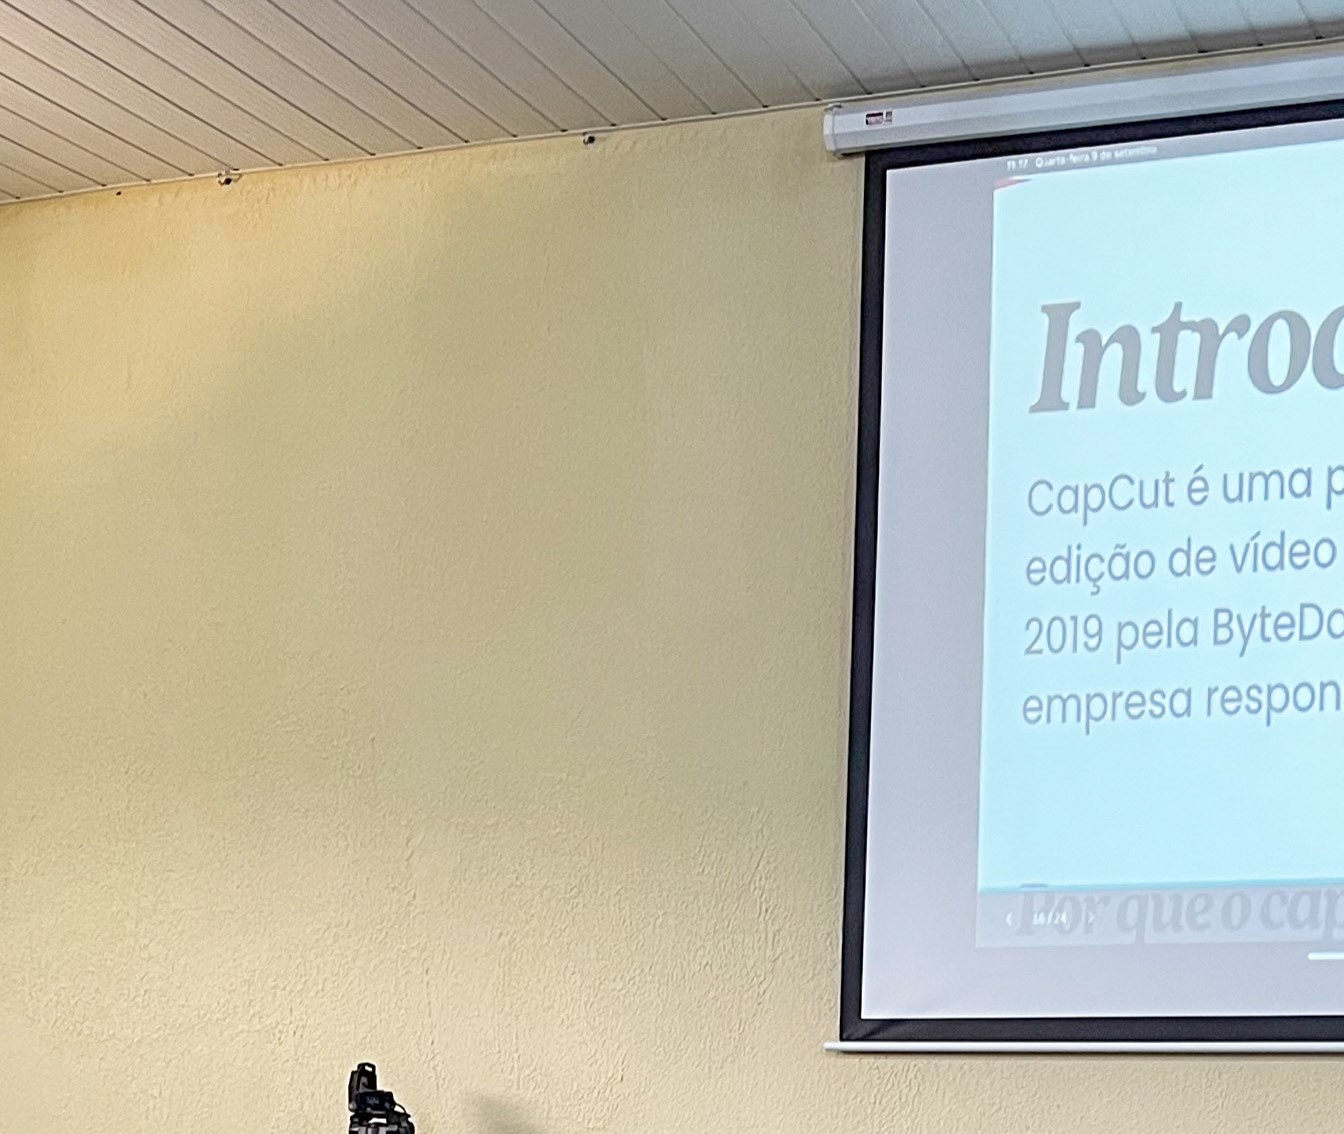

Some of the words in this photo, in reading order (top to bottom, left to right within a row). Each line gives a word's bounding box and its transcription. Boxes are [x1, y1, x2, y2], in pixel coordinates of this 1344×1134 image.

[1027, 470, 1177, 529] CapCut
[1186, 463, 1211, 508] é
[1222, 466, 1314, 505] uma
[1024, 541, 1158, 598] edição
[1167, 533, 1219, 580] de
[1228, 527, 1338, 578] vídeo
[1022, 612, 1104, 657] 2019
[1114, 607, 1201, 666] pela
[1021, 685, 1194, 737] empresa
[1015, 884, 1111, 936] Por
[1117, 891, 1213, 943] que
[1220, 892, 1252, 931] o
